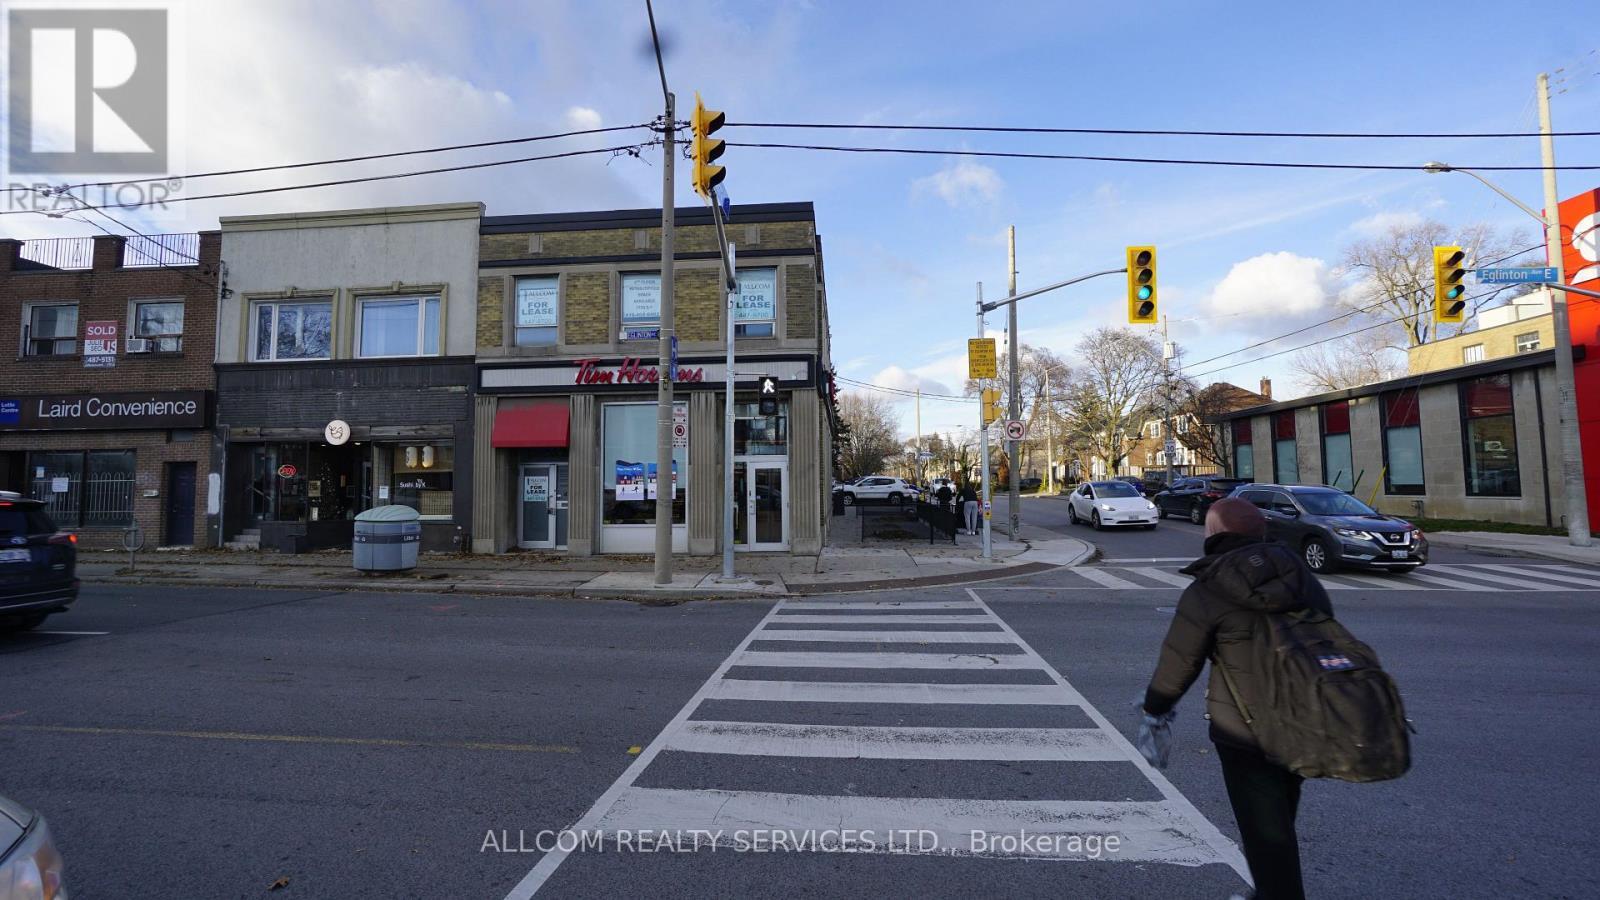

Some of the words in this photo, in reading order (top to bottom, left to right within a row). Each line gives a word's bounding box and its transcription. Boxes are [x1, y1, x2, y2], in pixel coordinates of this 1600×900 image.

[1482, 269, 1527, 283] Eglinton
[1545, 268, 1552, 279] E
[736, 301, 771, 309] LEASE
[521, 308, 554, 316] LEASE
[87, 326, 116, 336] SOLD
[574, 357, 614, 385] Tim
[617, 356, 703, 383] Horns
[38, 399, 81, 418] Laird
[87, 398, 197, 417] Convenience
